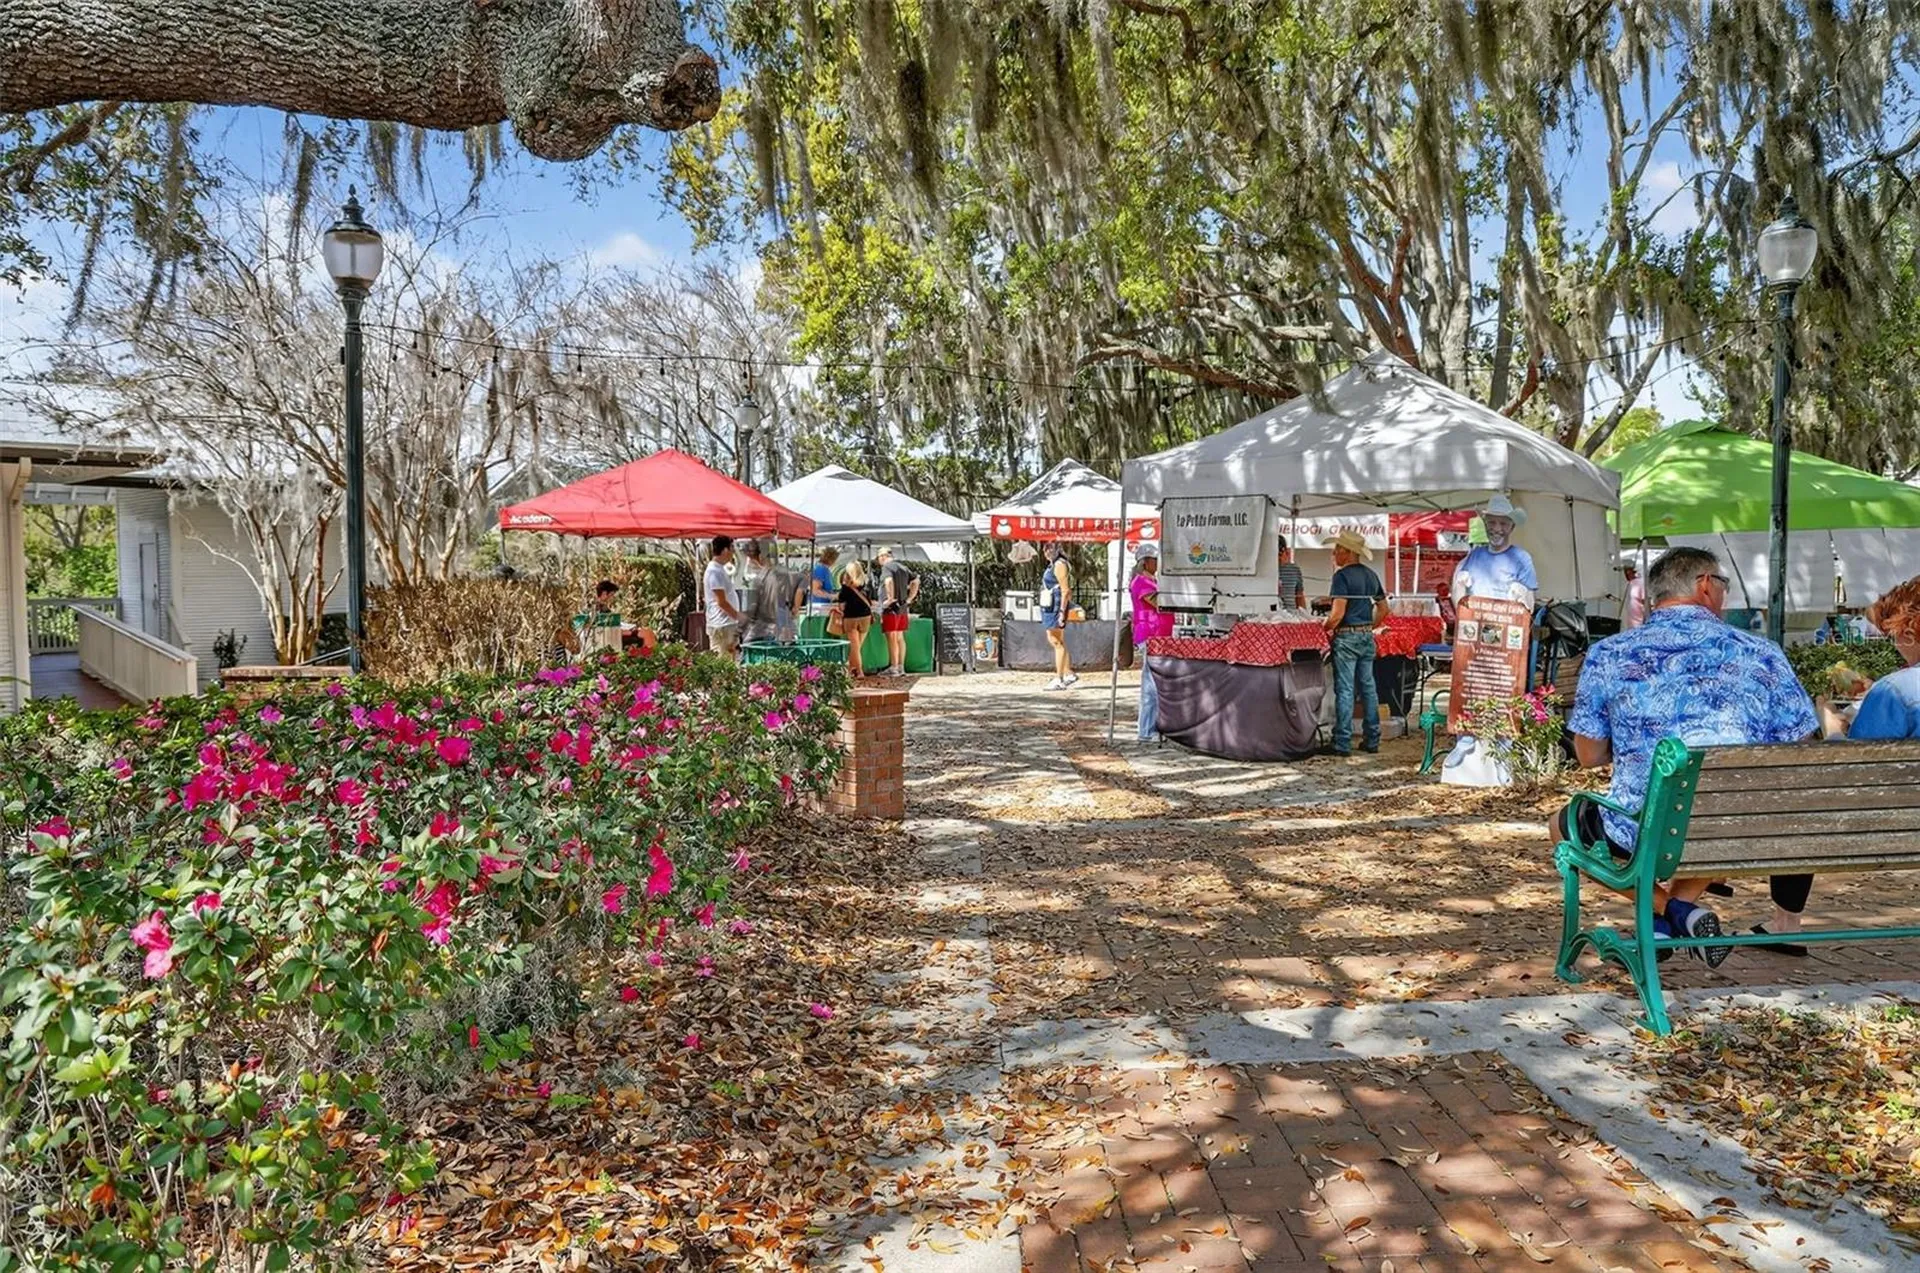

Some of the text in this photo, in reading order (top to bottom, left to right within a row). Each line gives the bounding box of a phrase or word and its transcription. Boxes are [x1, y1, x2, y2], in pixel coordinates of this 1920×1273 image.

[510, 514, 552, 524] Academ
[1020, 518, 1084, 529] BURRATA
[1279, 524, 1322, 535] IEROGI
